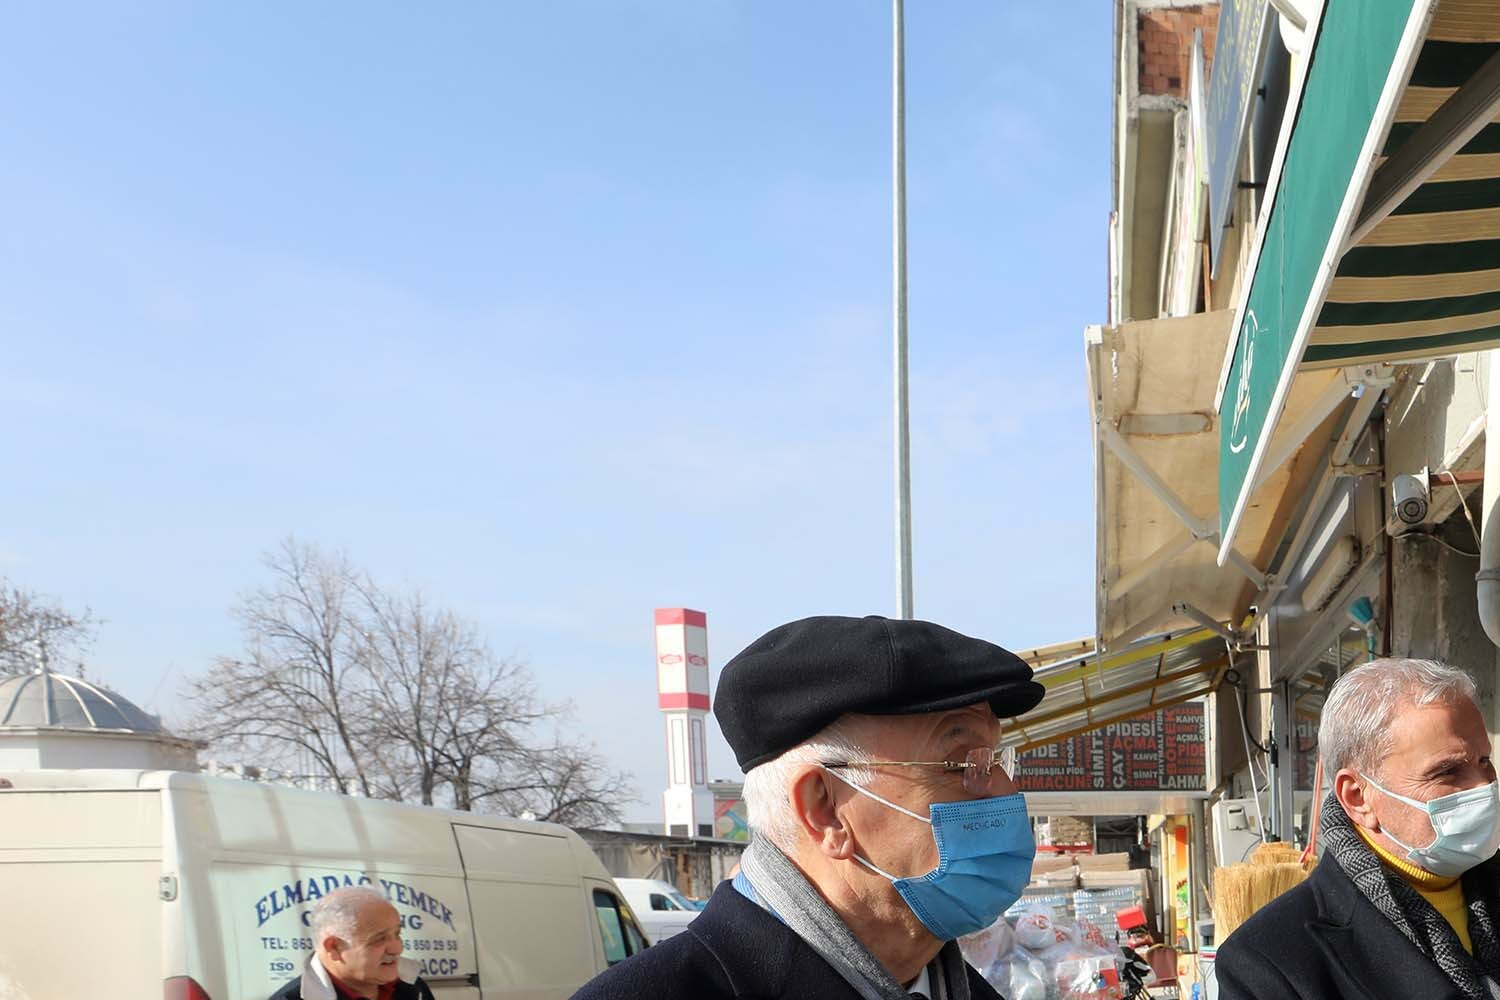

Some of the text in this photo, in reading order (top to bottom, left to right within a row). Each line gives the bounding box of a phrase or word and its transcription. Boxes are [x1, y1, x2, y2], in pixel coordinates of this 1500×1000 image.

[380, 879, 456, 933] YEMEK
[261, 937, 288, 950] TEL:
[270, 961, 295, 972] ISO
[418, 958, 458, 976] ACCP
